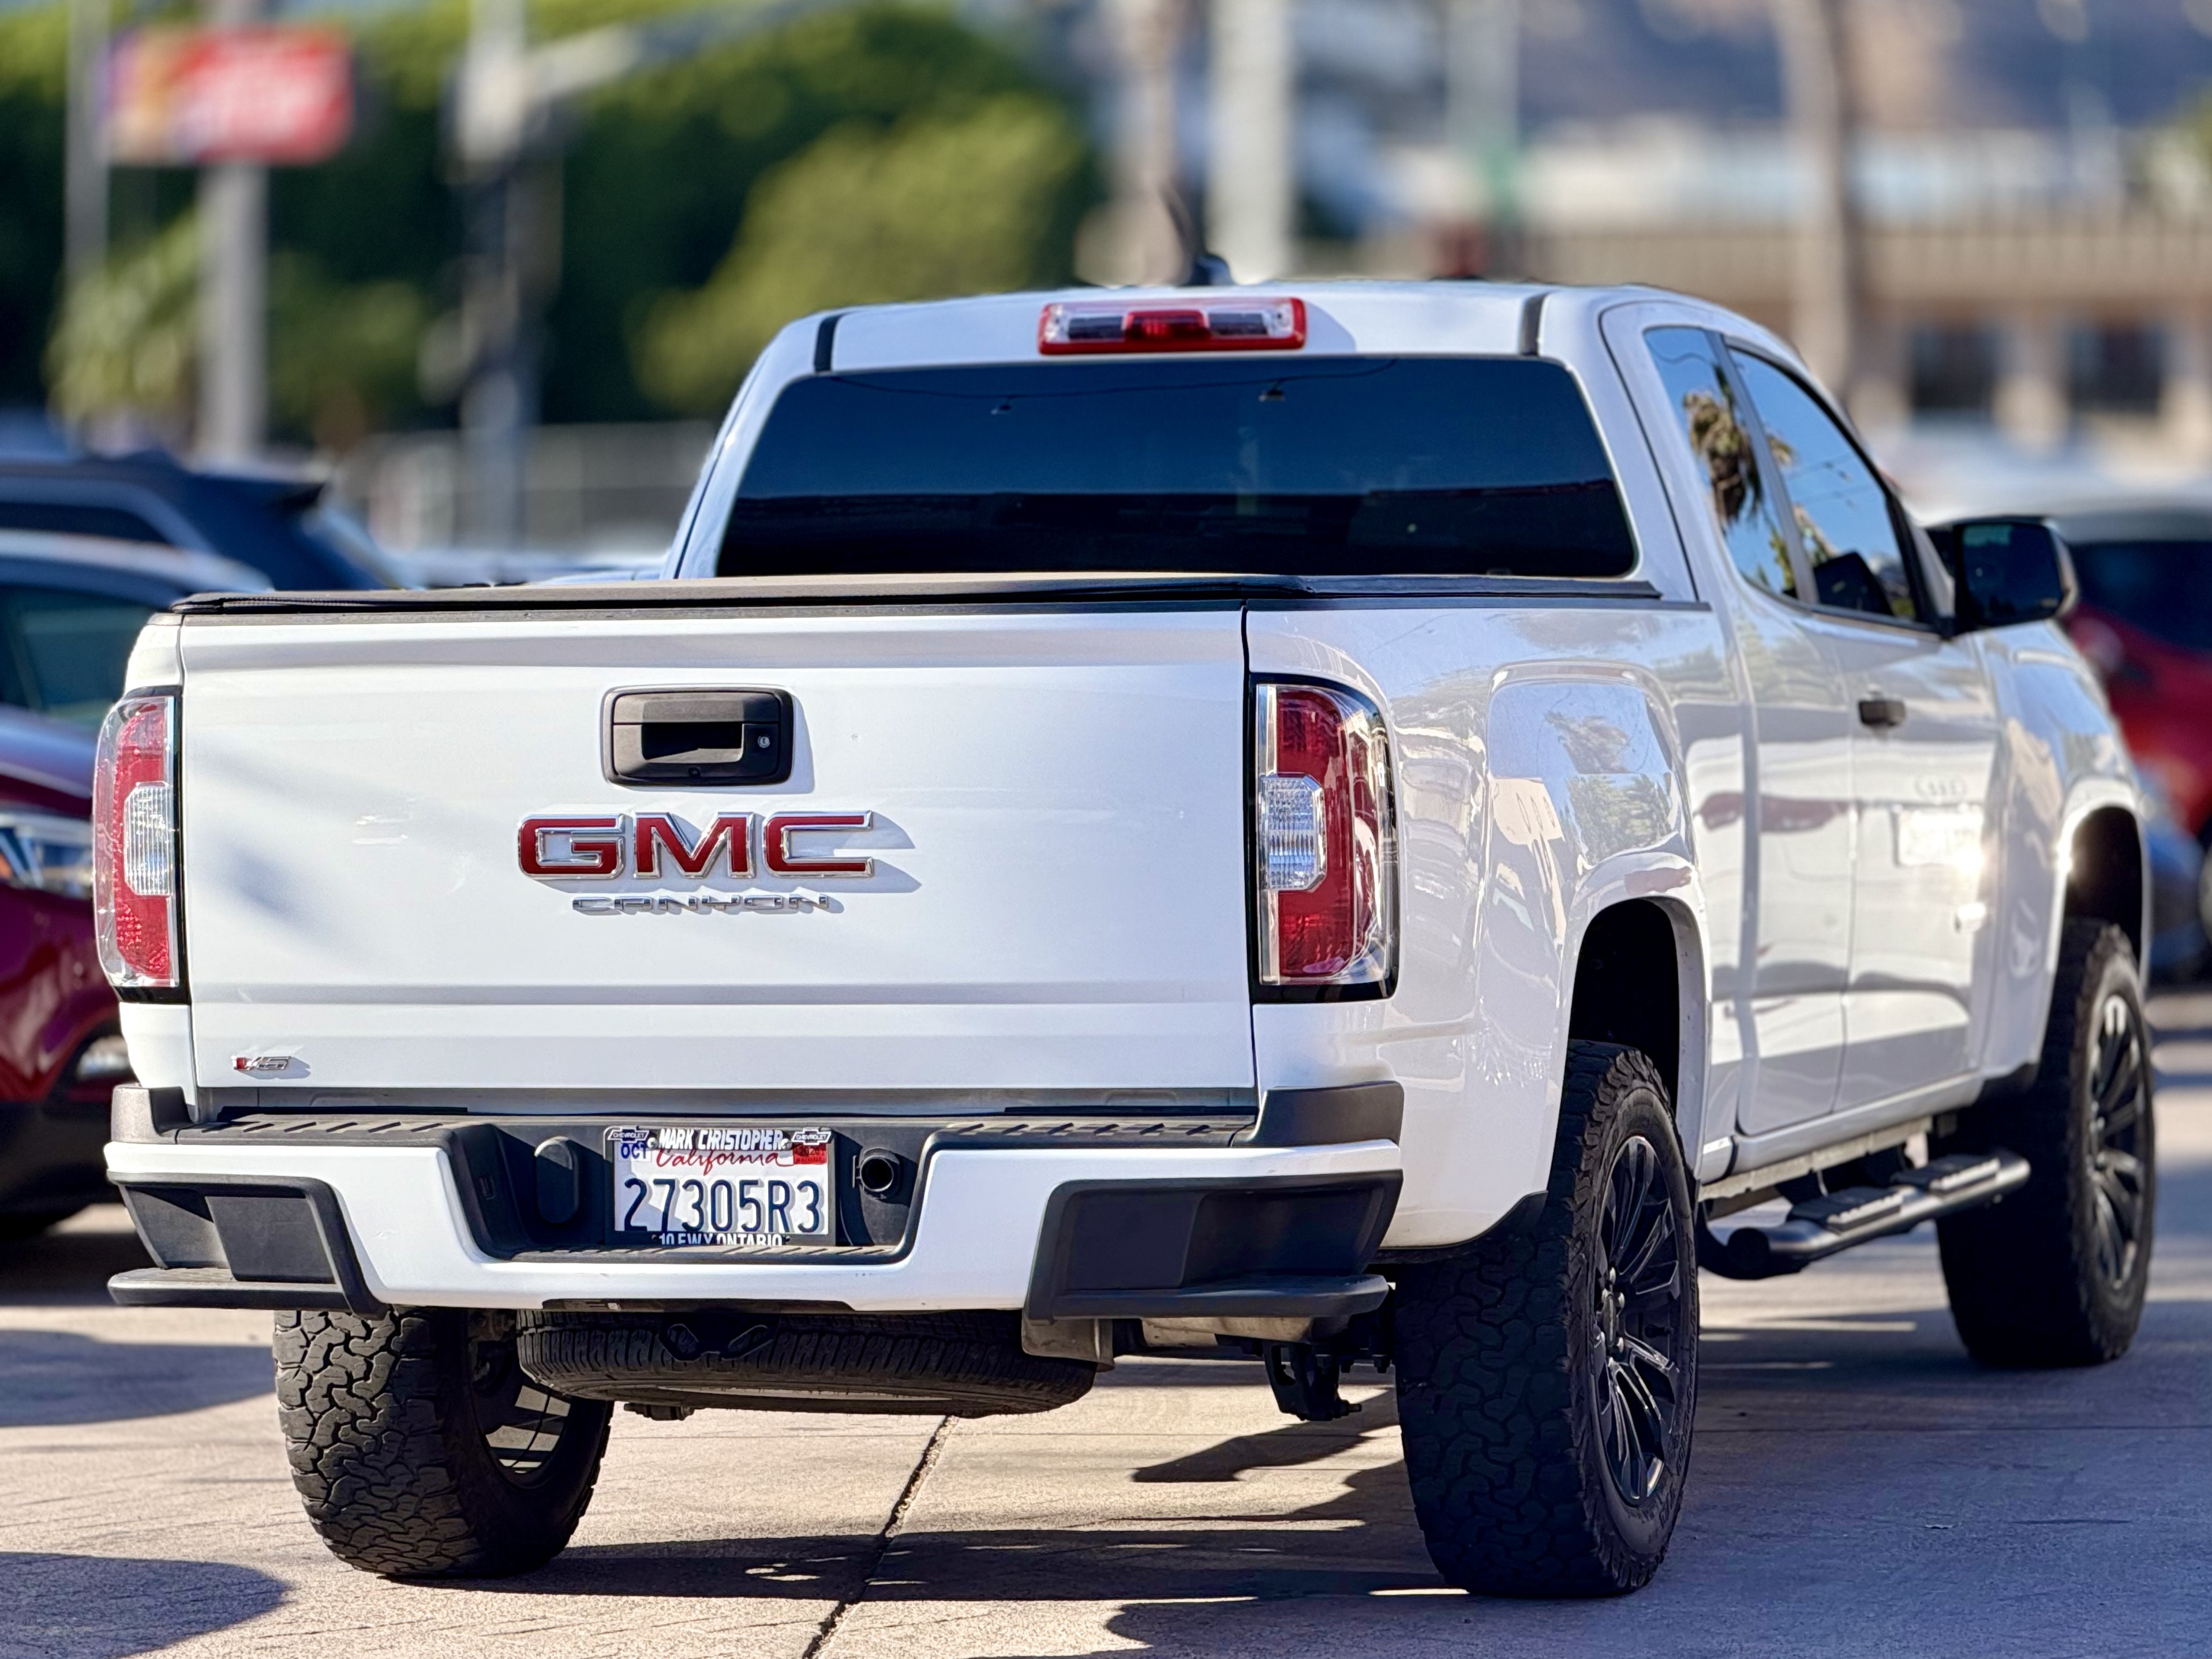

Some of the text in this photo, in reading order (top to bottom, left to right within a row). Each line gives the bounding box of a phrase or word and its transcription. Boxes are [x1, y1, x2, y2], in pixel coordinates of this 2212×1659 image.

[517, 810, 874, 878] GMC
[572, 890, 828, 912] CANYON
[620, 1142, 647, 1159] OCT
[658, 1128, 695, 1150] MARK
[698, 1129, 783, 1151] CHRISTOPHER
[656, 1147, 795, 1175] California
[624, 1177, 819, 1233] 27305R3
[659, 1233, 675, 1245] 10
[716, 1233, 783, 1246] ONTARIO
